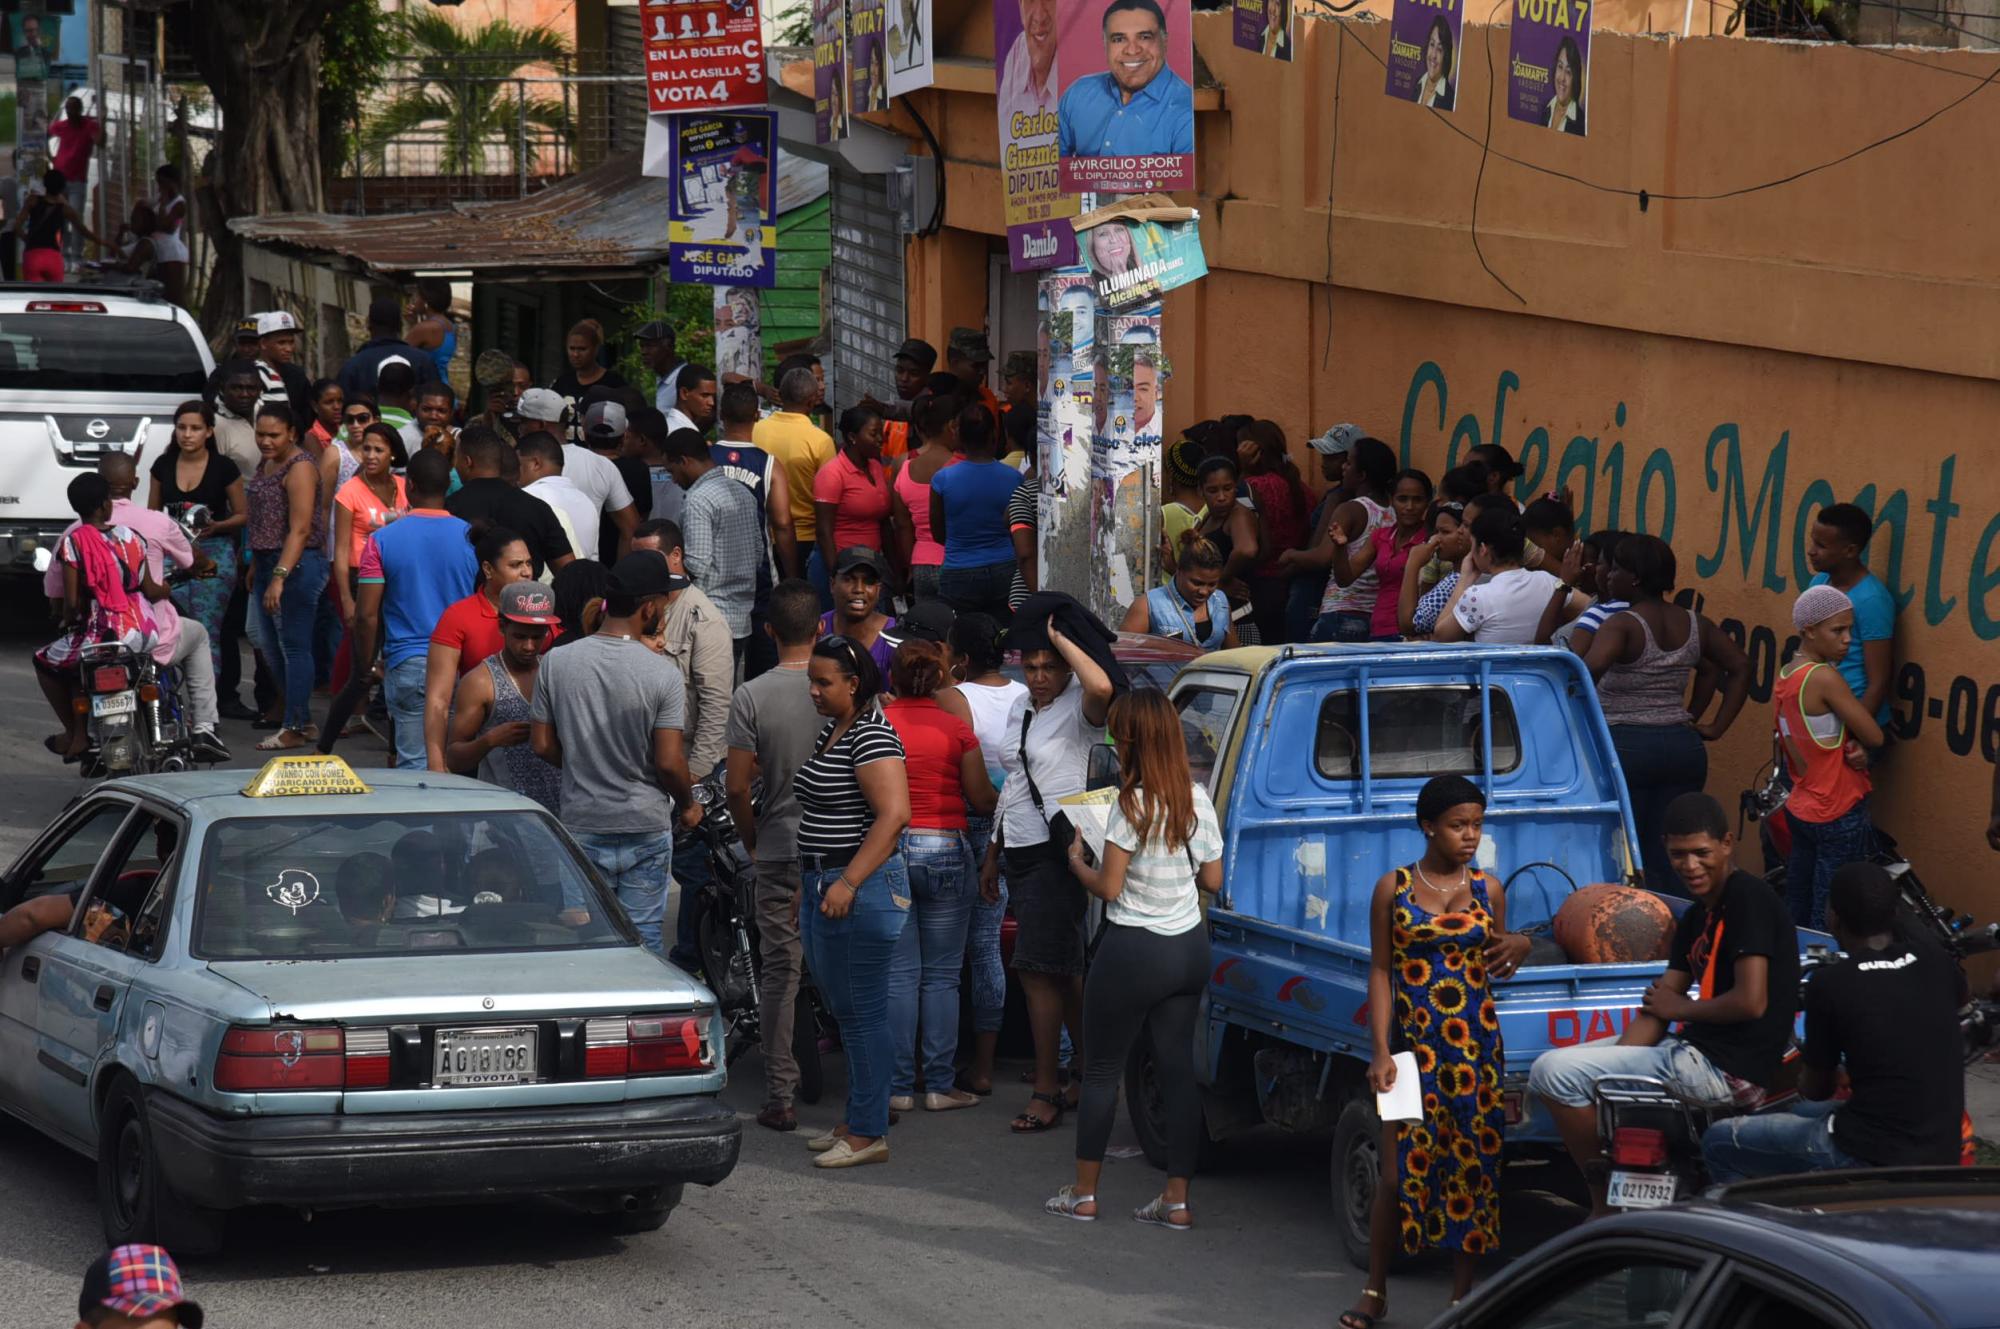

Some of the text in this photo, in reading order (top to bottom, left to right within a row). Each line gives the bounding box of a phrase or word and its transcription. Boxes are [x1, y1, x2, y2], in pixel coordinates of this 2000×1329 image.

[876, 8, 884, 31] 7
[1575, 1, 1588, 32] 7
[649, 39, 759, 61] EN LA BOLETA C
[652, 63, 762, 84] EN LA CASILLA 3
[655, 80, 729, 103] VOTA 4
[1005, 136, 1059, 171] Guzmá
[1069, 156, 1183, 171] #VIRGILIO SPORT
[1008, 169, 1059, 195] DIPUTAD
[1073, 169, 1183, 180] EL DIPUTADO DE TODOS
[1023, 229, 1058, 259] Danilo
[693, 265, 753, 278] DIPUTADO
[1099, 258, 1168, 296] ILUMINADA
[283, 761, 334, 769] RUTA
[304, 769, 319, 778] CON
[322, 768, 346, 778] GOMEZ
[263, 786, 364, 797] NOCTURNO
[272, 778, 328, 787] UARICANOS
[464, 1073, 515, 1083] TOYOTA
